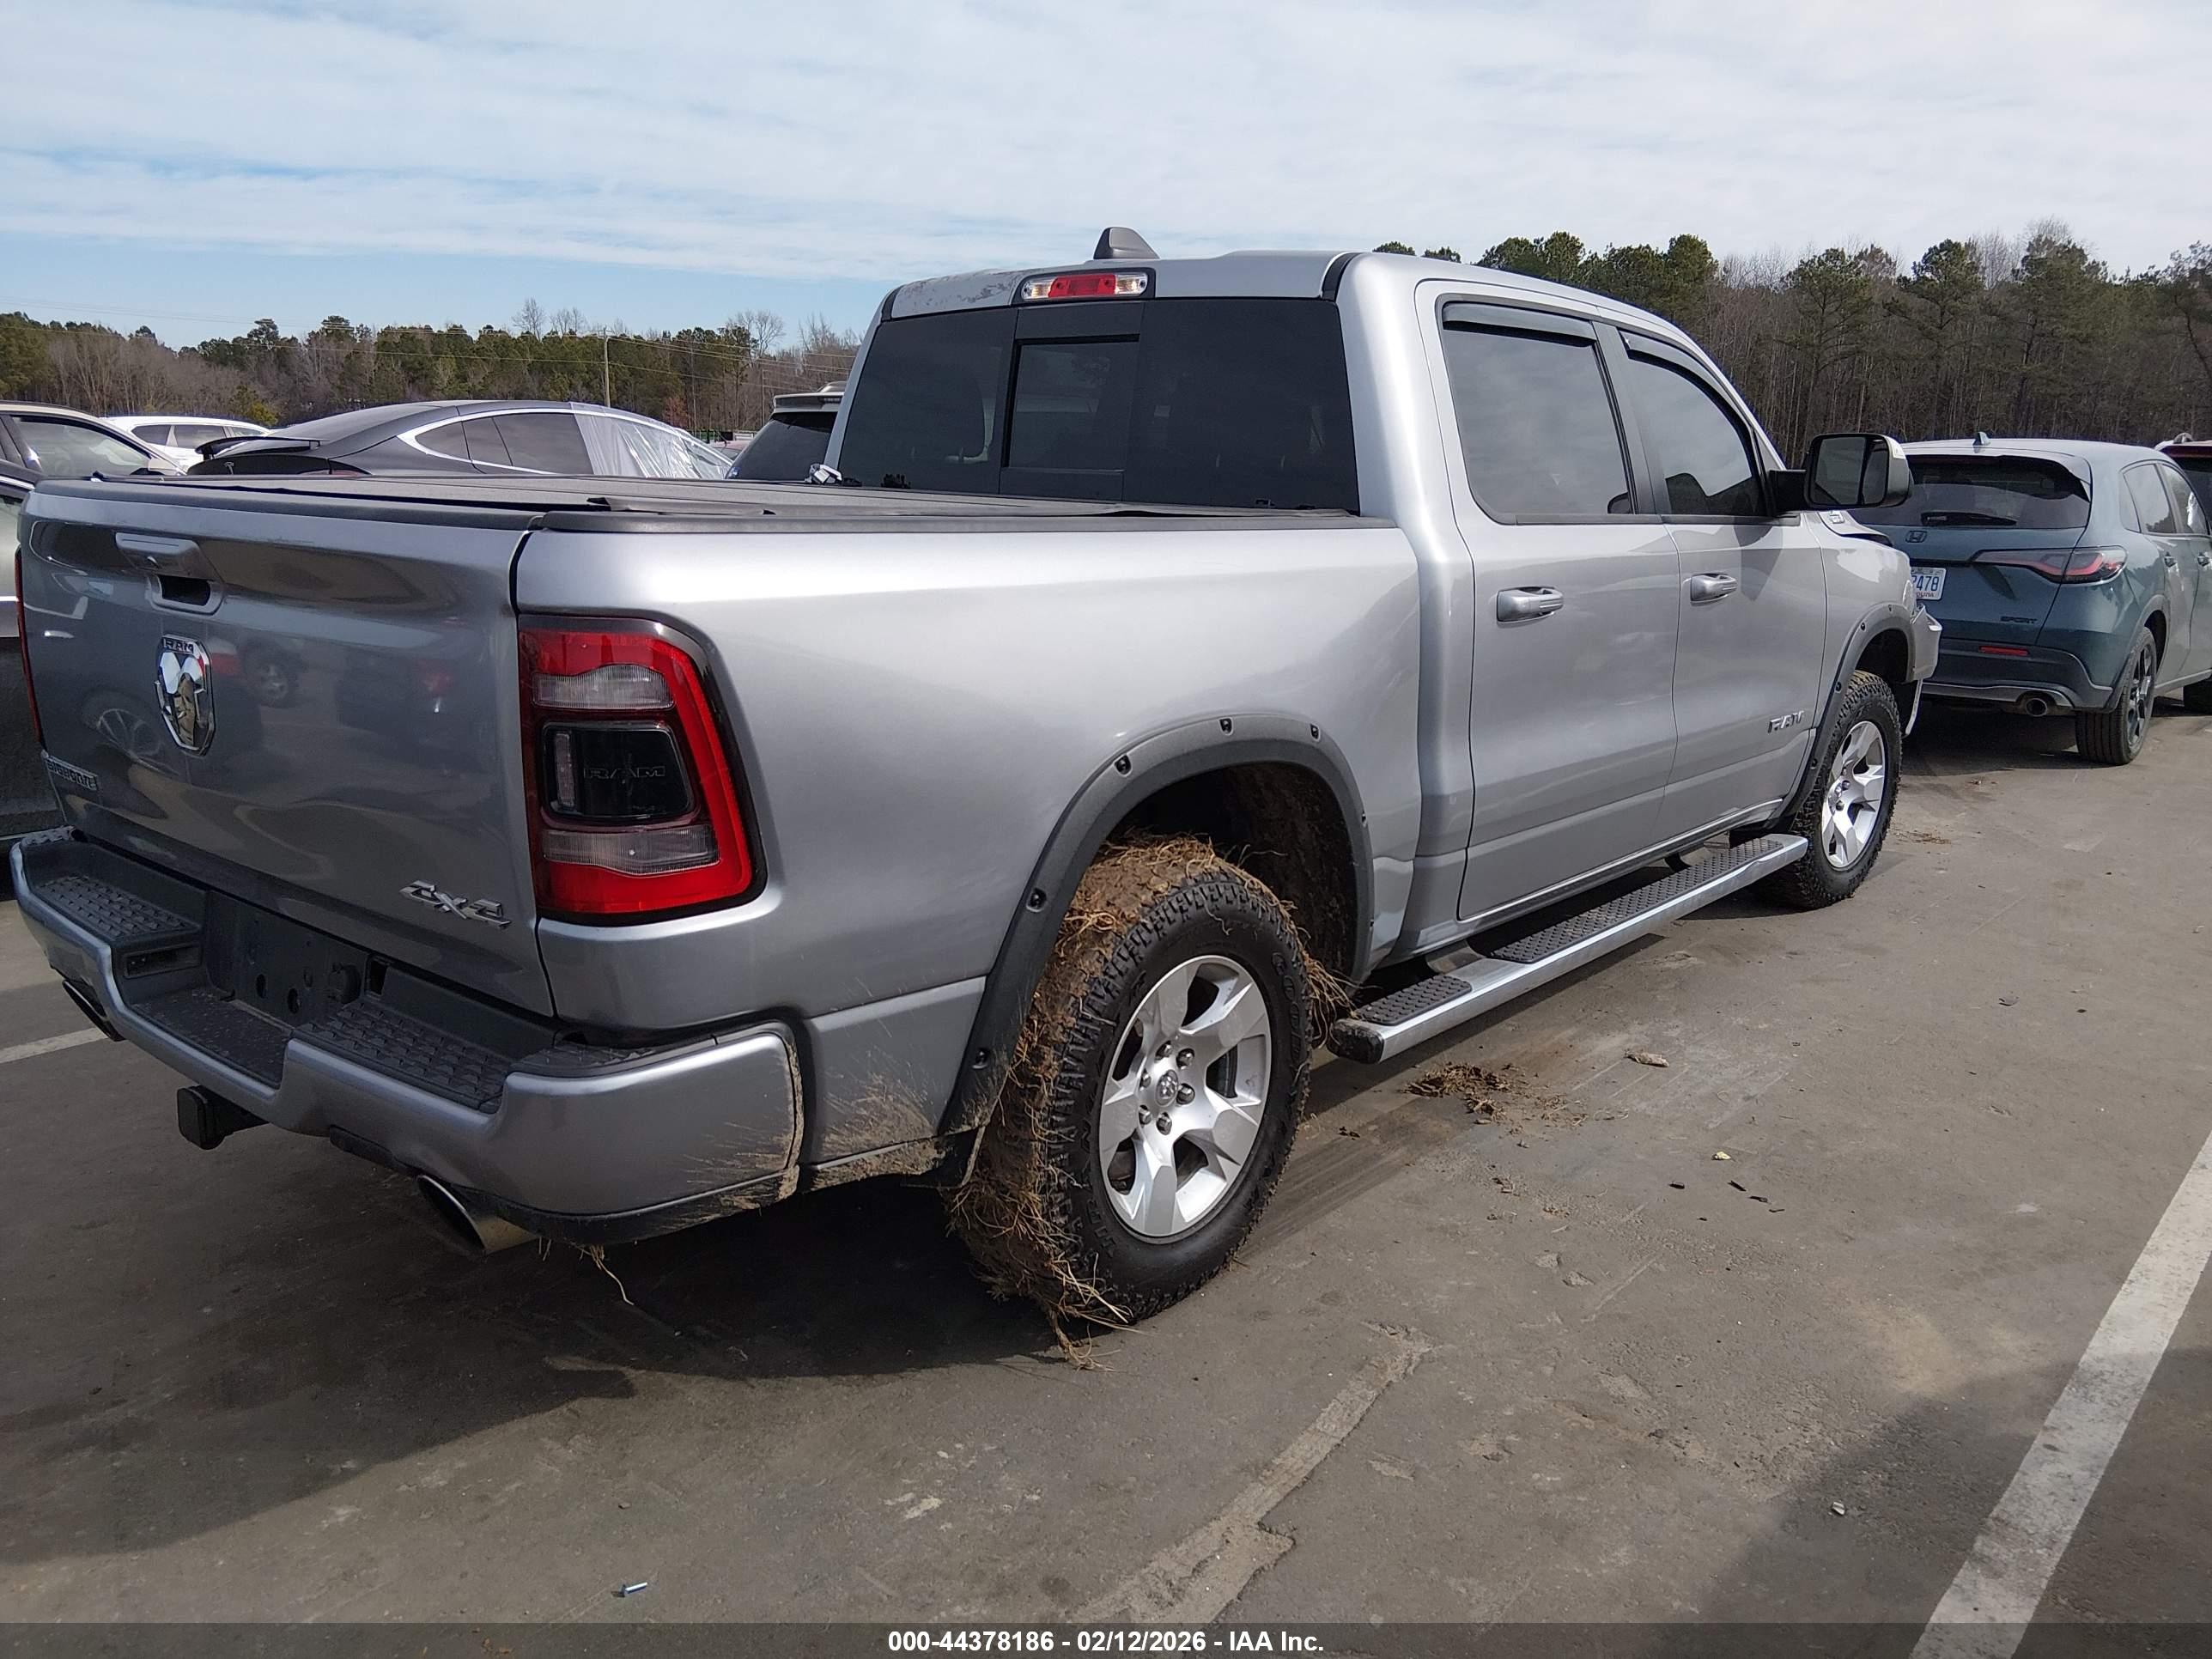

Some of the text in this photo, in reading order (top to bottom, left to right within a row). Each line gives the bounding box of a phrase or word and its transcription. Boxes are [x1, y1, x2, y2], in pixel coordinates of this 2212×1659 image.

[2000, 616, 2038, 624] SPORT
[163, 638, 194, 654] RAM
[1768, 711, 1805, 733] RAM
[583, 766, 665, 779] RAM
